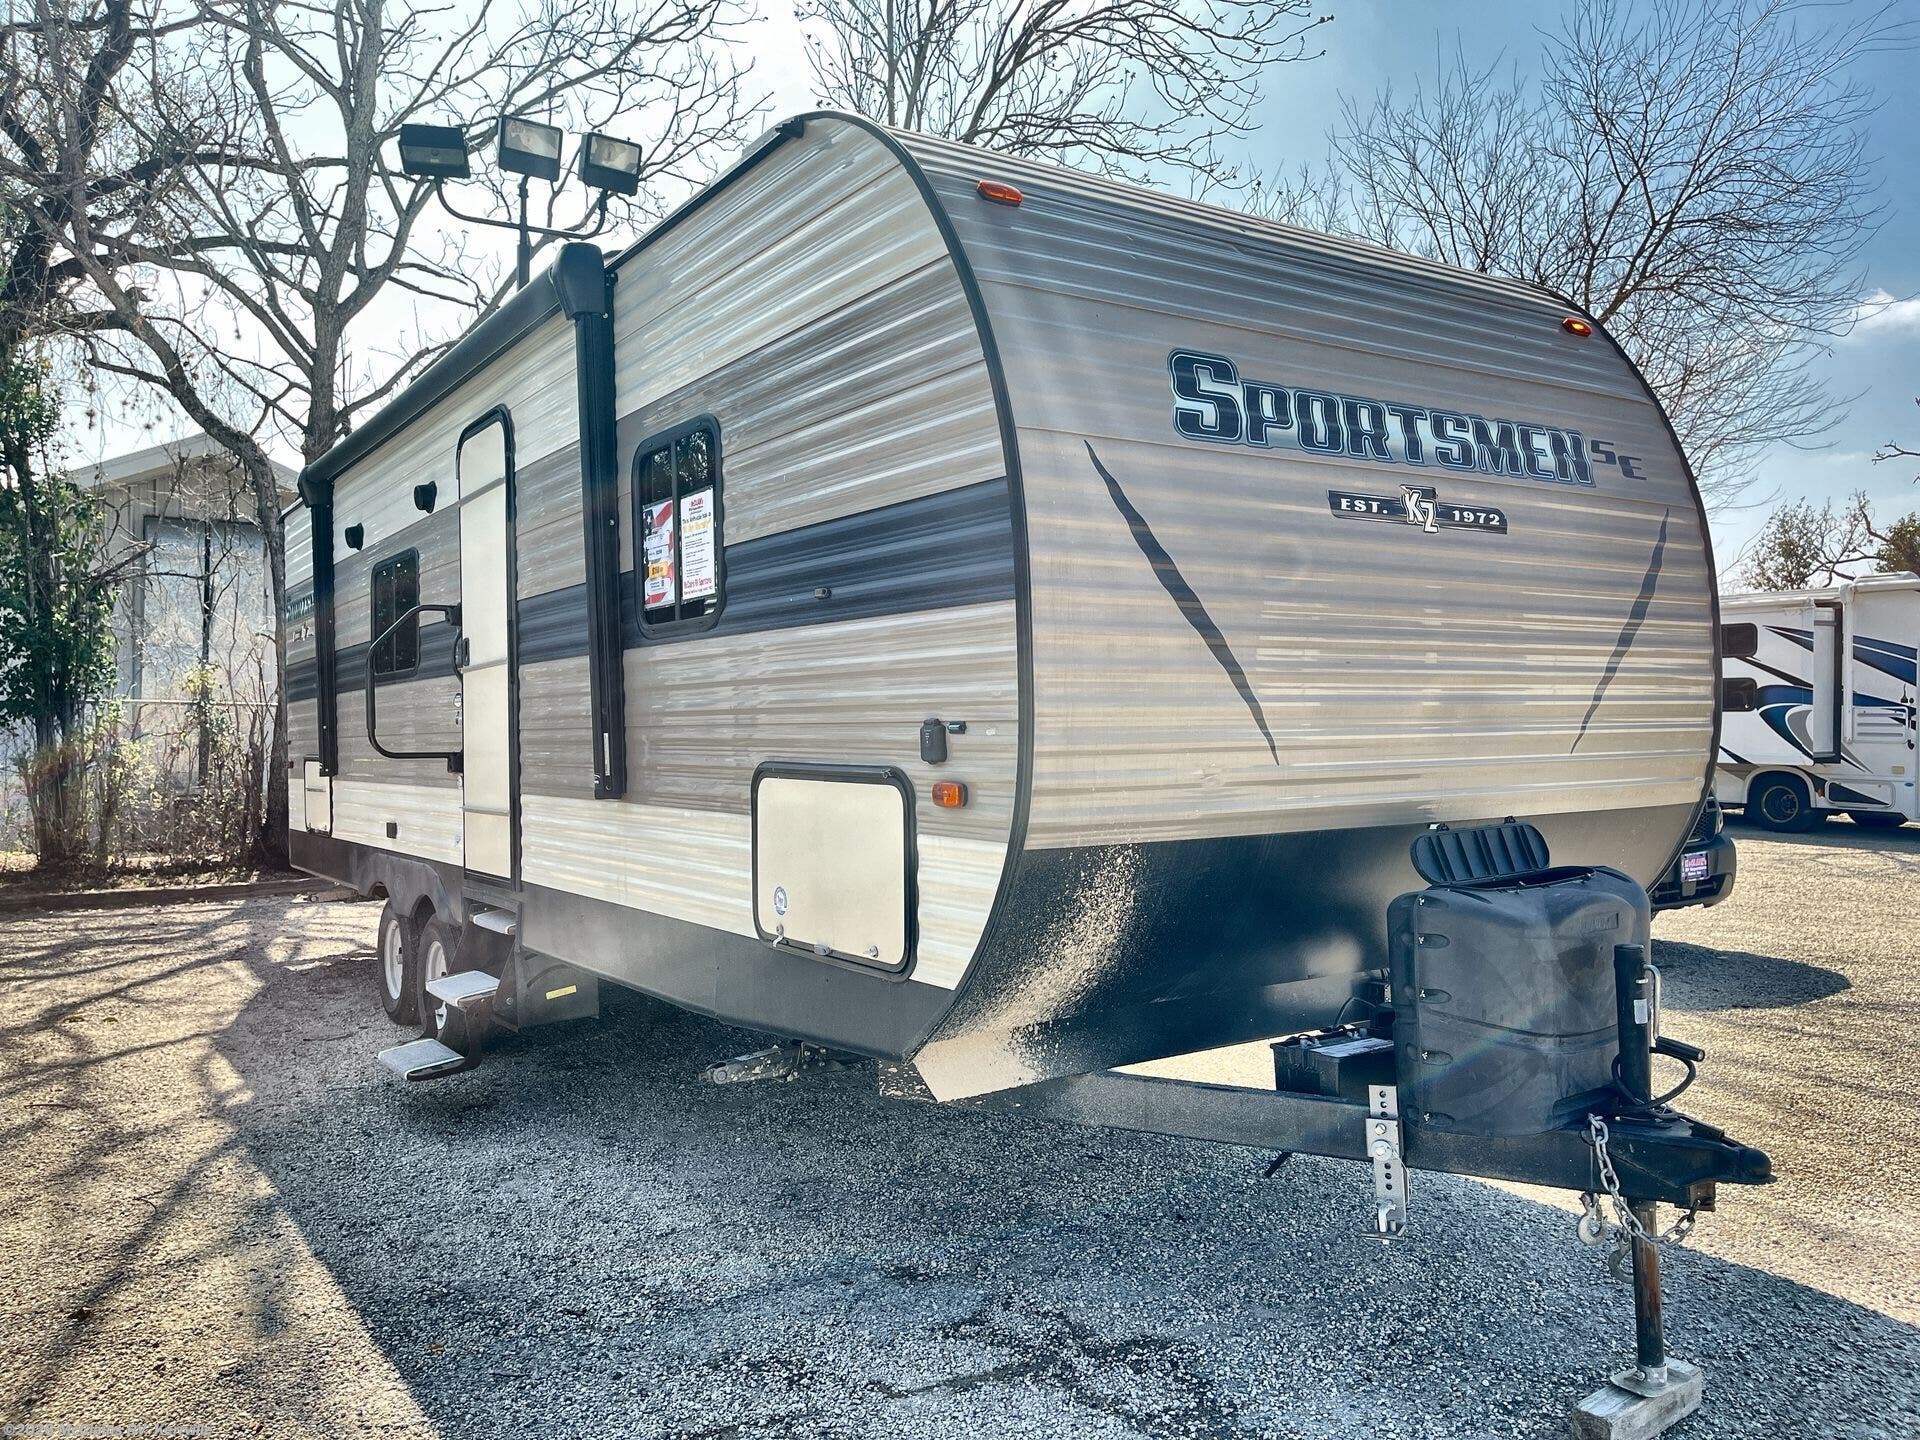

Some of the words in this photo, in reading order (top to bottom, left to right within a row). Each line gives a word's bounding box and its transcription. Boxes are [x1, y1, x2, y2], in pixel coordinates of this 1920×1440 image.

[1168, 349, 1596, 487] SPORTSMEN
[1591, 440, 1648, 480] SE
[1340, 497, 1389, 515] EST.
[1401, 489, 1440, 534] KZ
[1452, 509, 1501, 526] 1972
